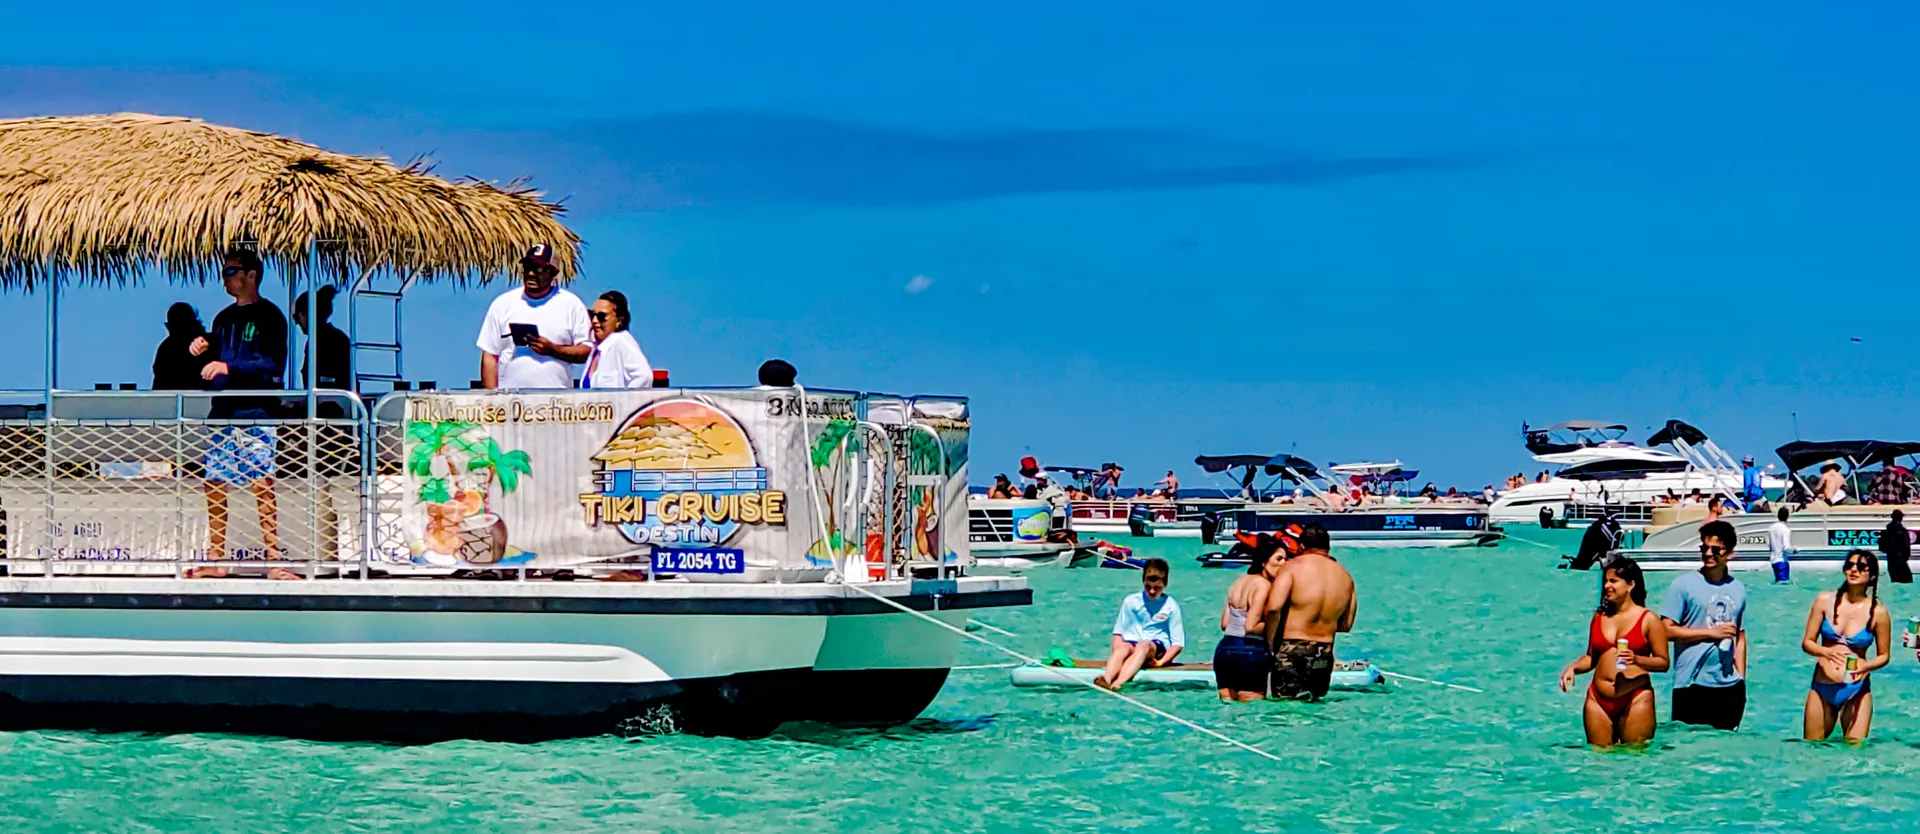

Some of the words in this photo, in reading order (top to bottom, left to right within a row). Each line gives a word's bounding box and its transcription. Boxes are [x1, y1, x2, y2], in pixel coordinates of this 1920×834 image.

[579, 492, 645, 525] TIKI
[656, 491, 786, 525] CRUISE
[1466, 516, 1478, 526] 61
[634, 524, 720, 544] DESTIN
[1835, 530, 1882, 538] BEAC
[656, 553, 675, 569] FL
[679, 552, 713, 569] 2054
[715, 553, 737, 570] TG
